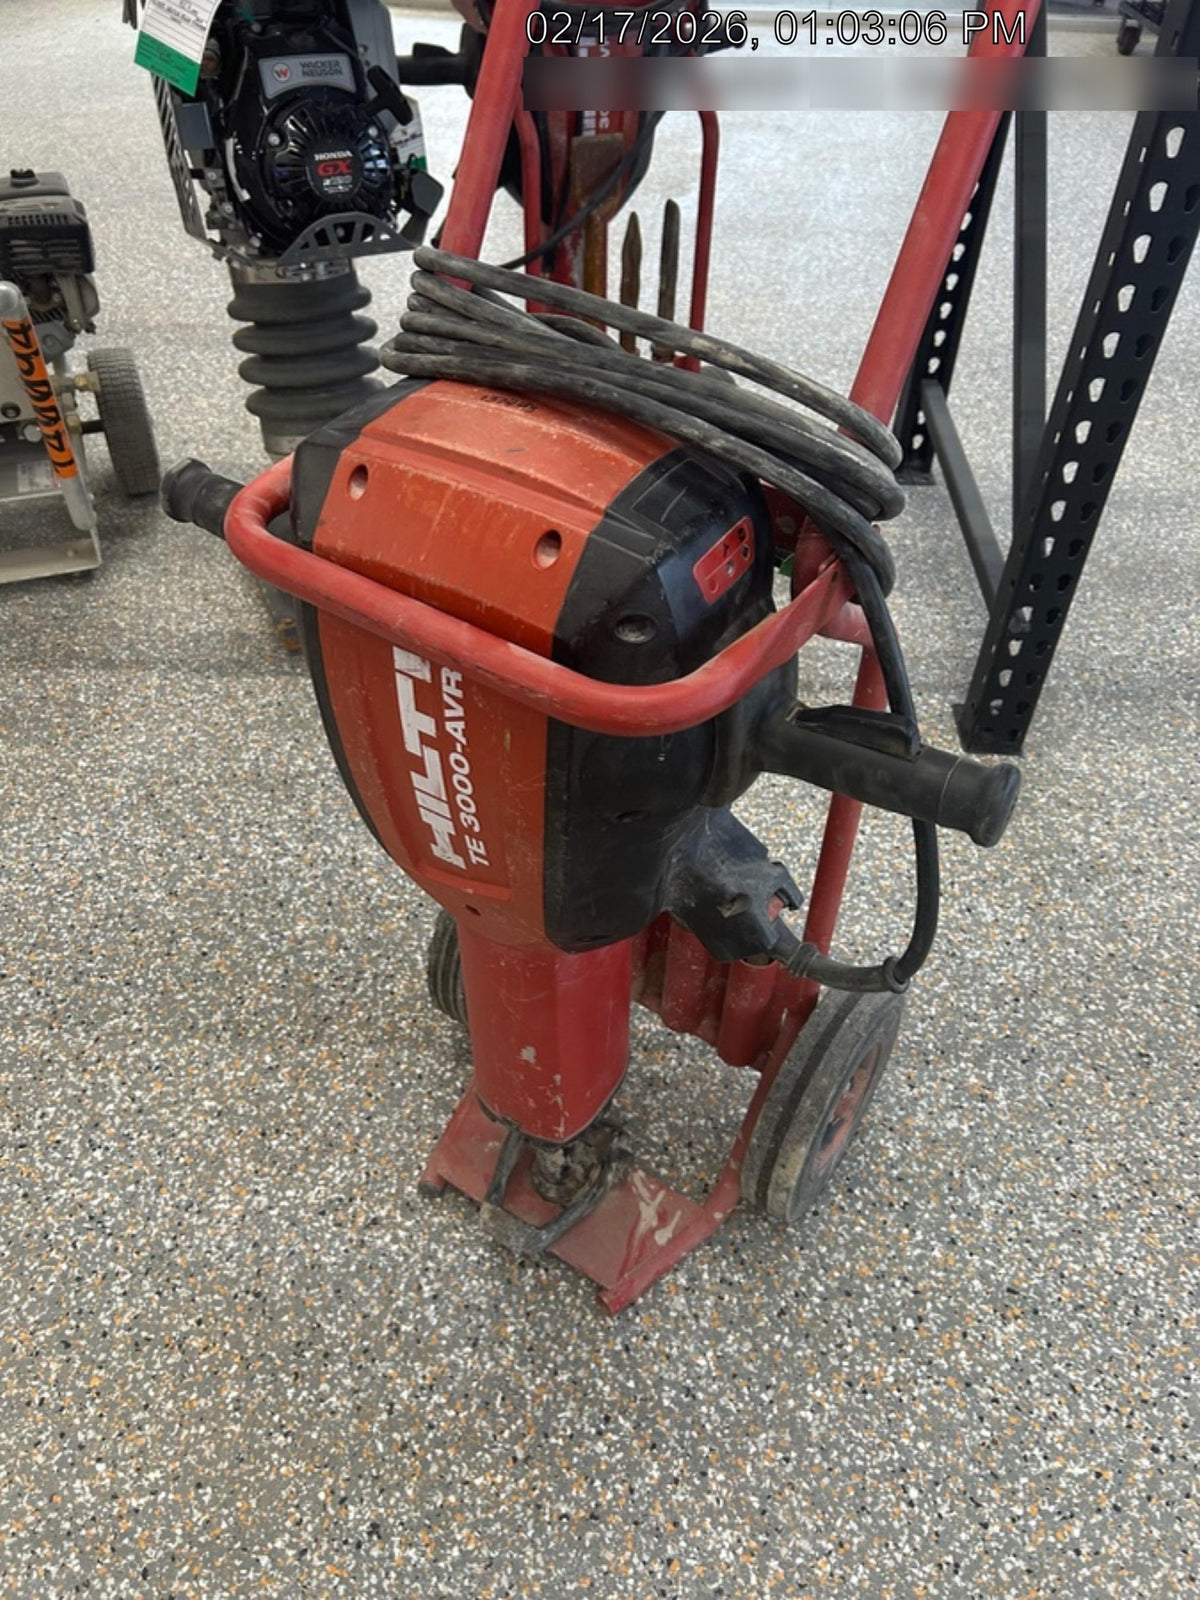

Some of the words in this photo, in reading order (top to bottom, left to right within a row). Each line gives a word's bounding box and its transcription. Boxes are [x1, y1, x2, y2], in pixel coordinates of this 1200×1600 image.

[299, 60, 341, 69] WACKER
[302, 68, 343, 77] NEUSON
[314, 150, 353, 160] HONDA
[317, 159, 354, 177] GX
[392, 645, 468, 870] HILTI
[441, 666, 482, 834] 3000-AVR
[465, 834, 490, 867] TE
